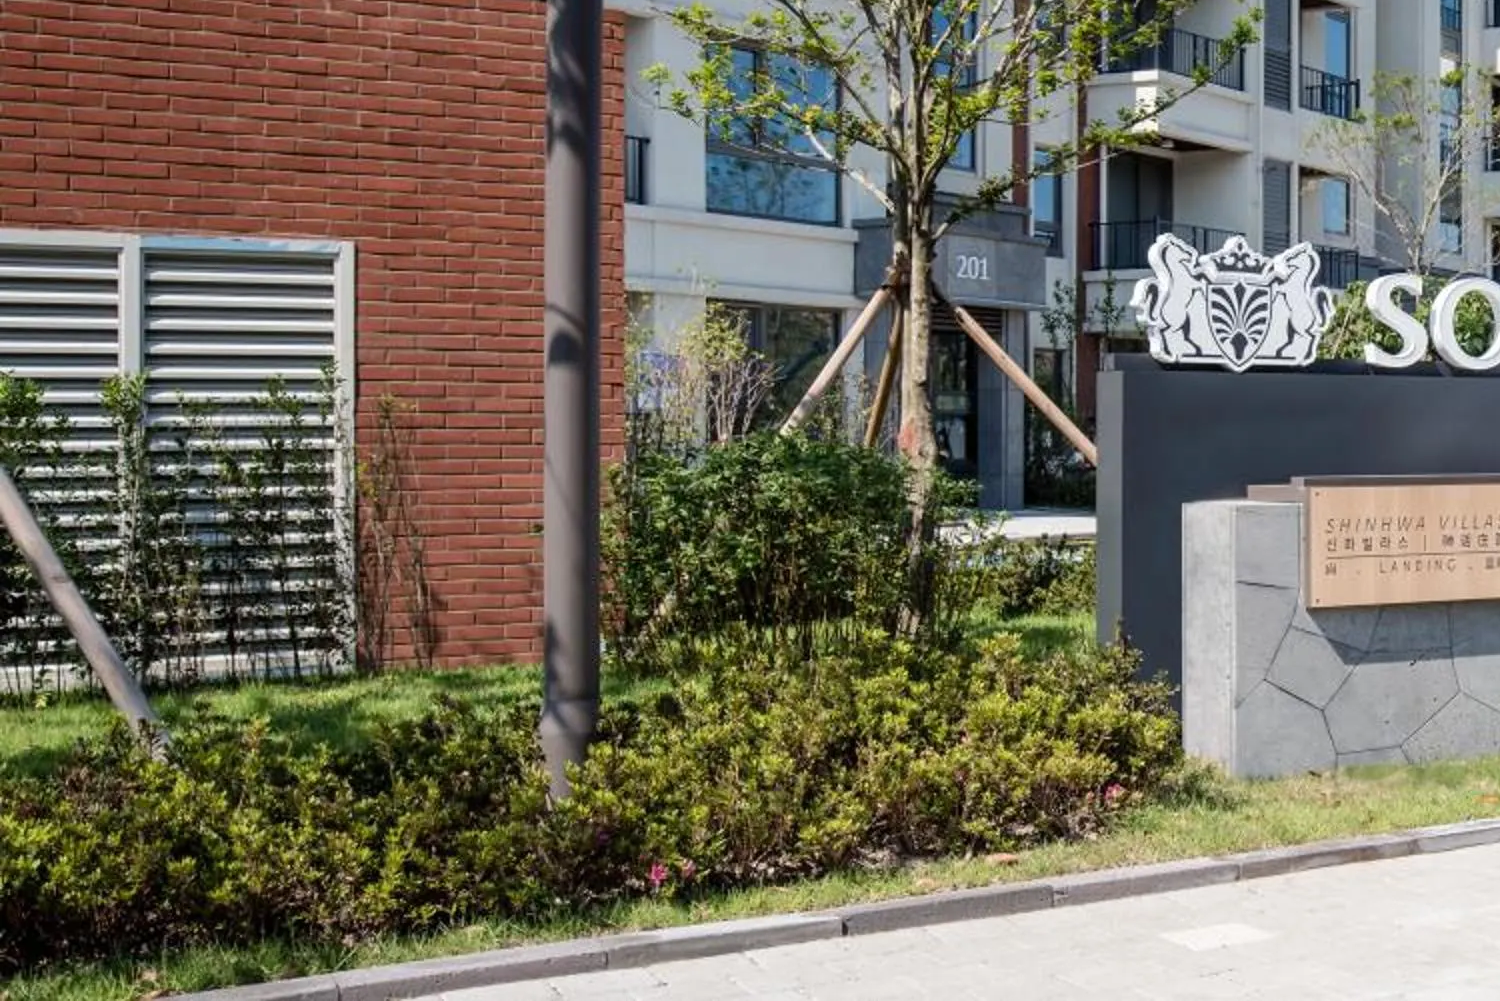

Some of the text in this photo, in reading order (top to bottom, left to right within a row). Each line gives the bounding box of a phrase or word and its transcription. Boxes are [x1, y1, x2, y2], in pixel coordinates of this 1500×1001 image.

[956, 254, 990, 281] 201
[1325, 516, 1426, 534] SHINHWA
[1379, 559, 1457, 575] LANDING
